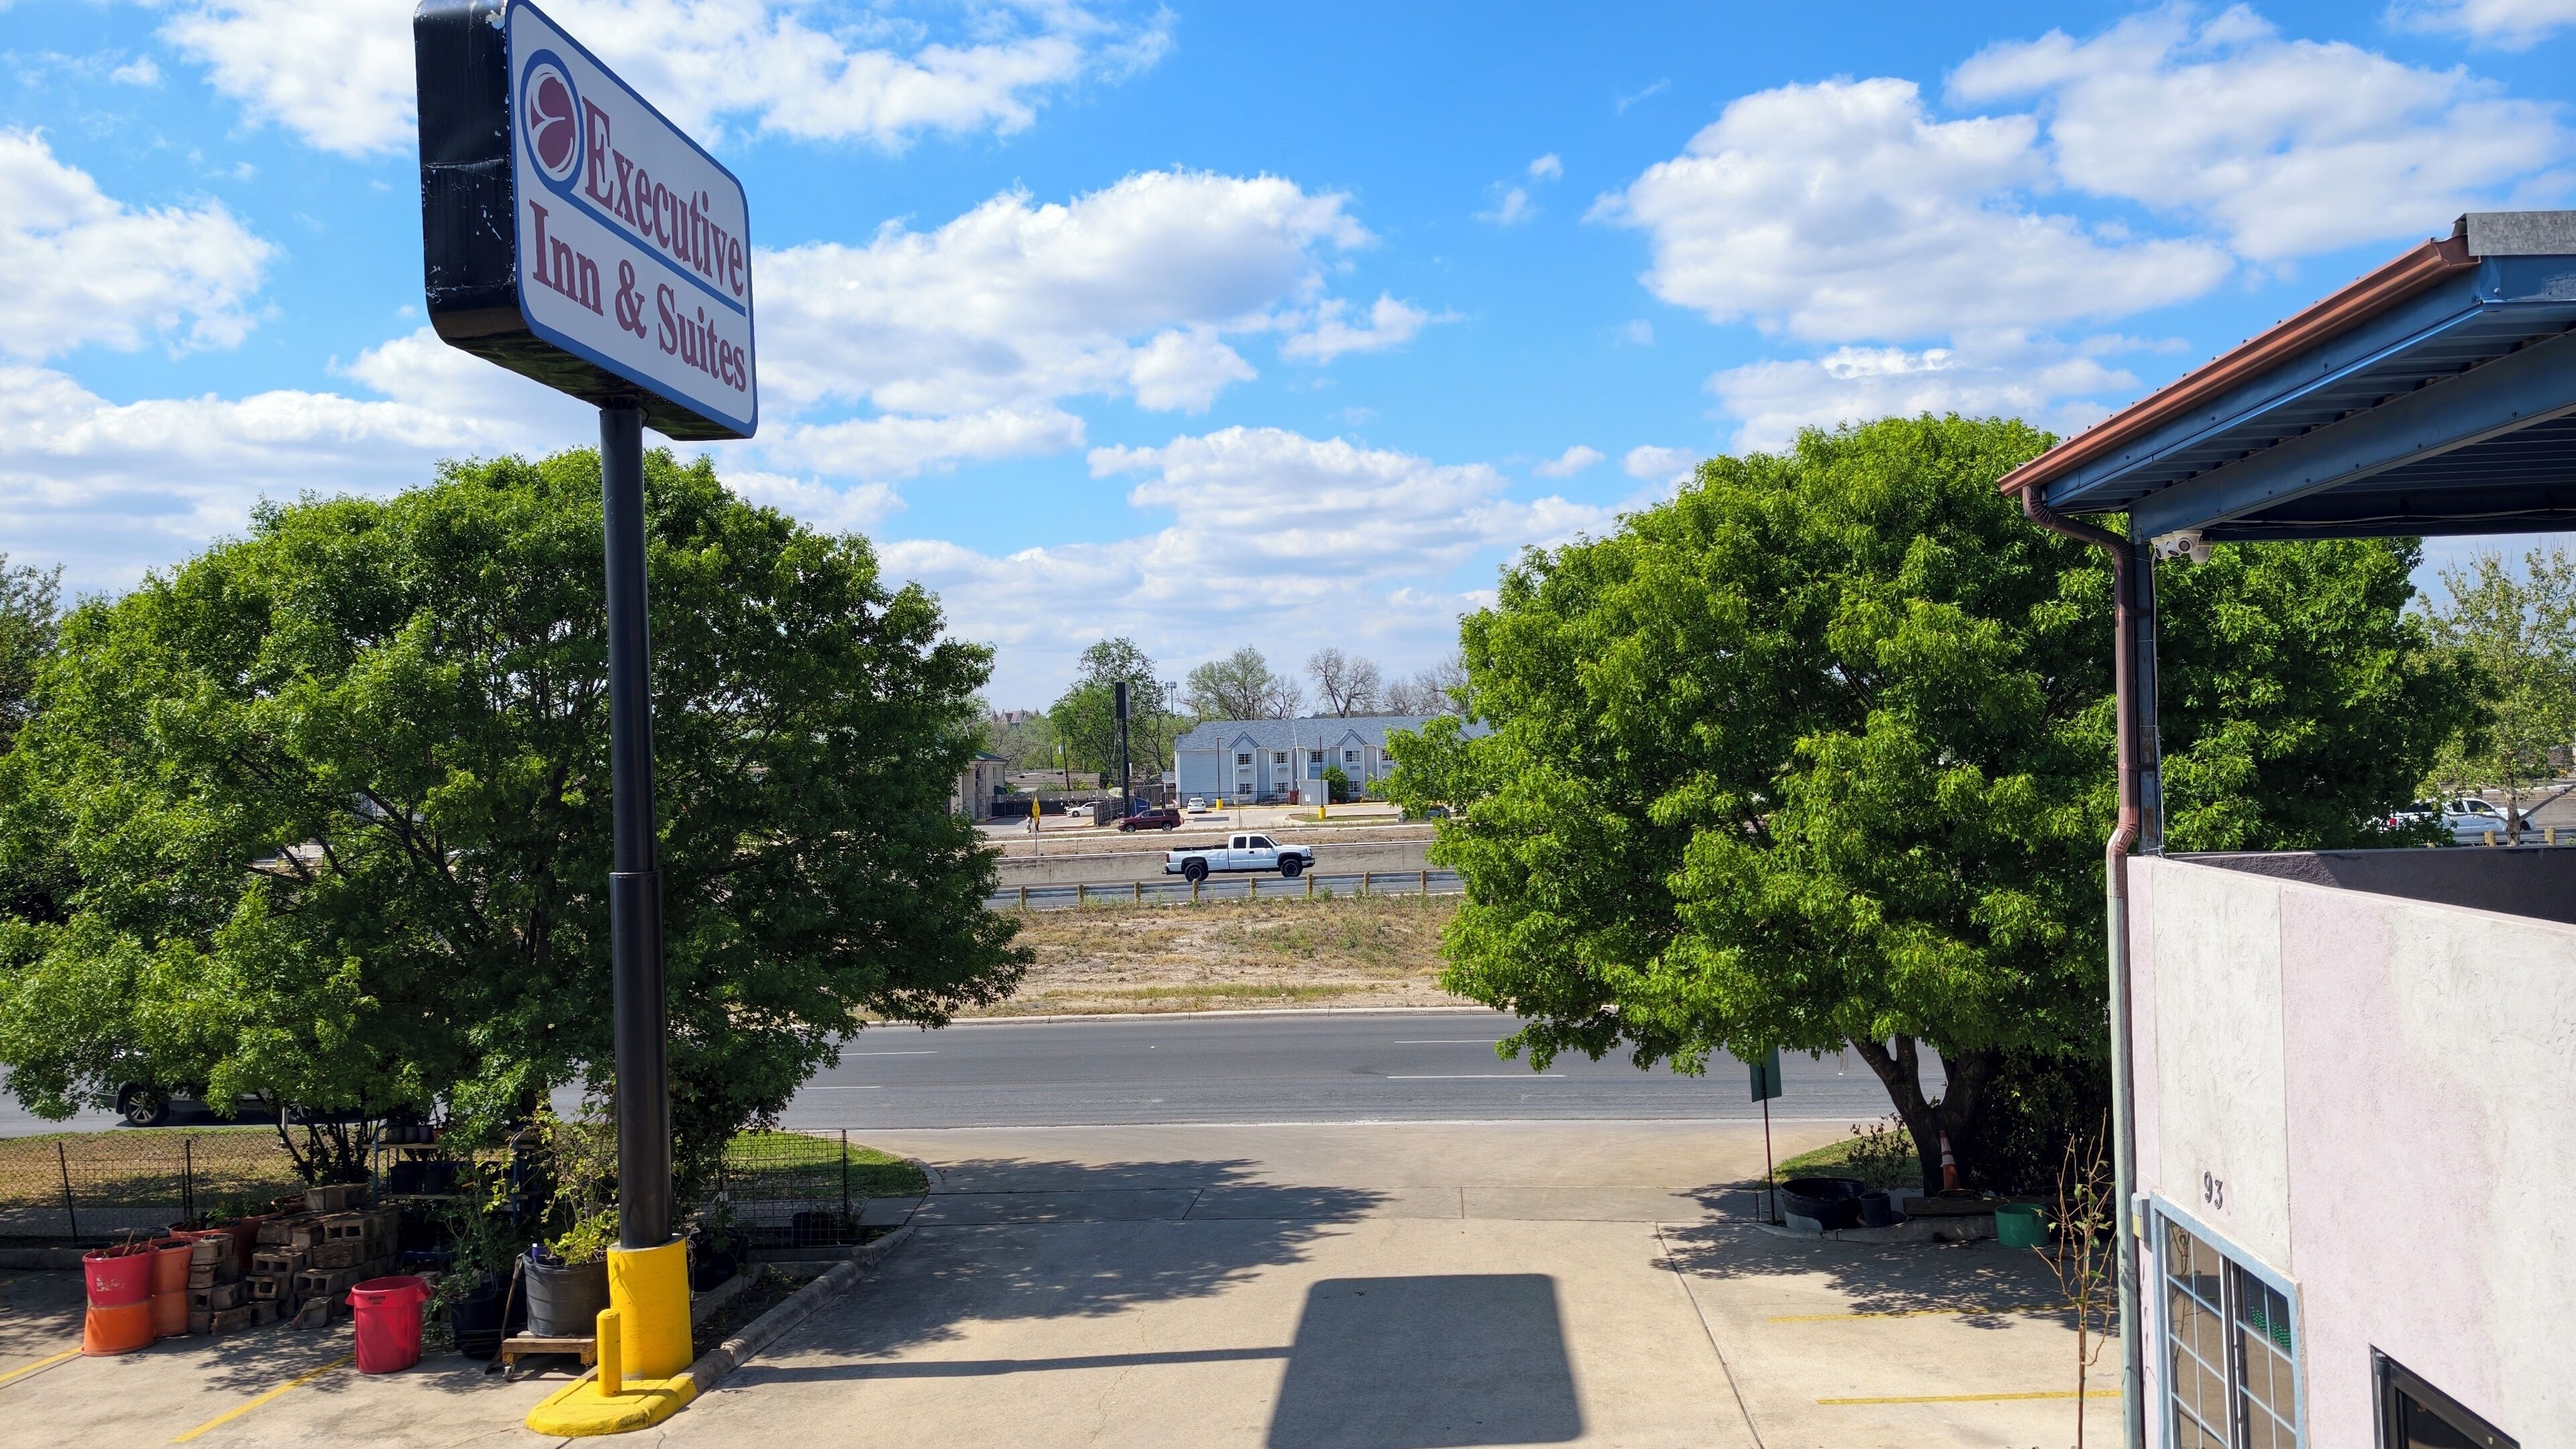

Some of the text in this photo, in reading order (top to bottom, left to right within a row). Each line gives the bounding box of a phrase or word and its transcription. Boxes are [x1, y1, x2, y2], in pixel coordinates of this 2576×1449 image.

[582, 96, 744, 297] Executive
[529, 199, 746, 393] Inn & Suites
[2204, 1171, 2223, 1210] 93
